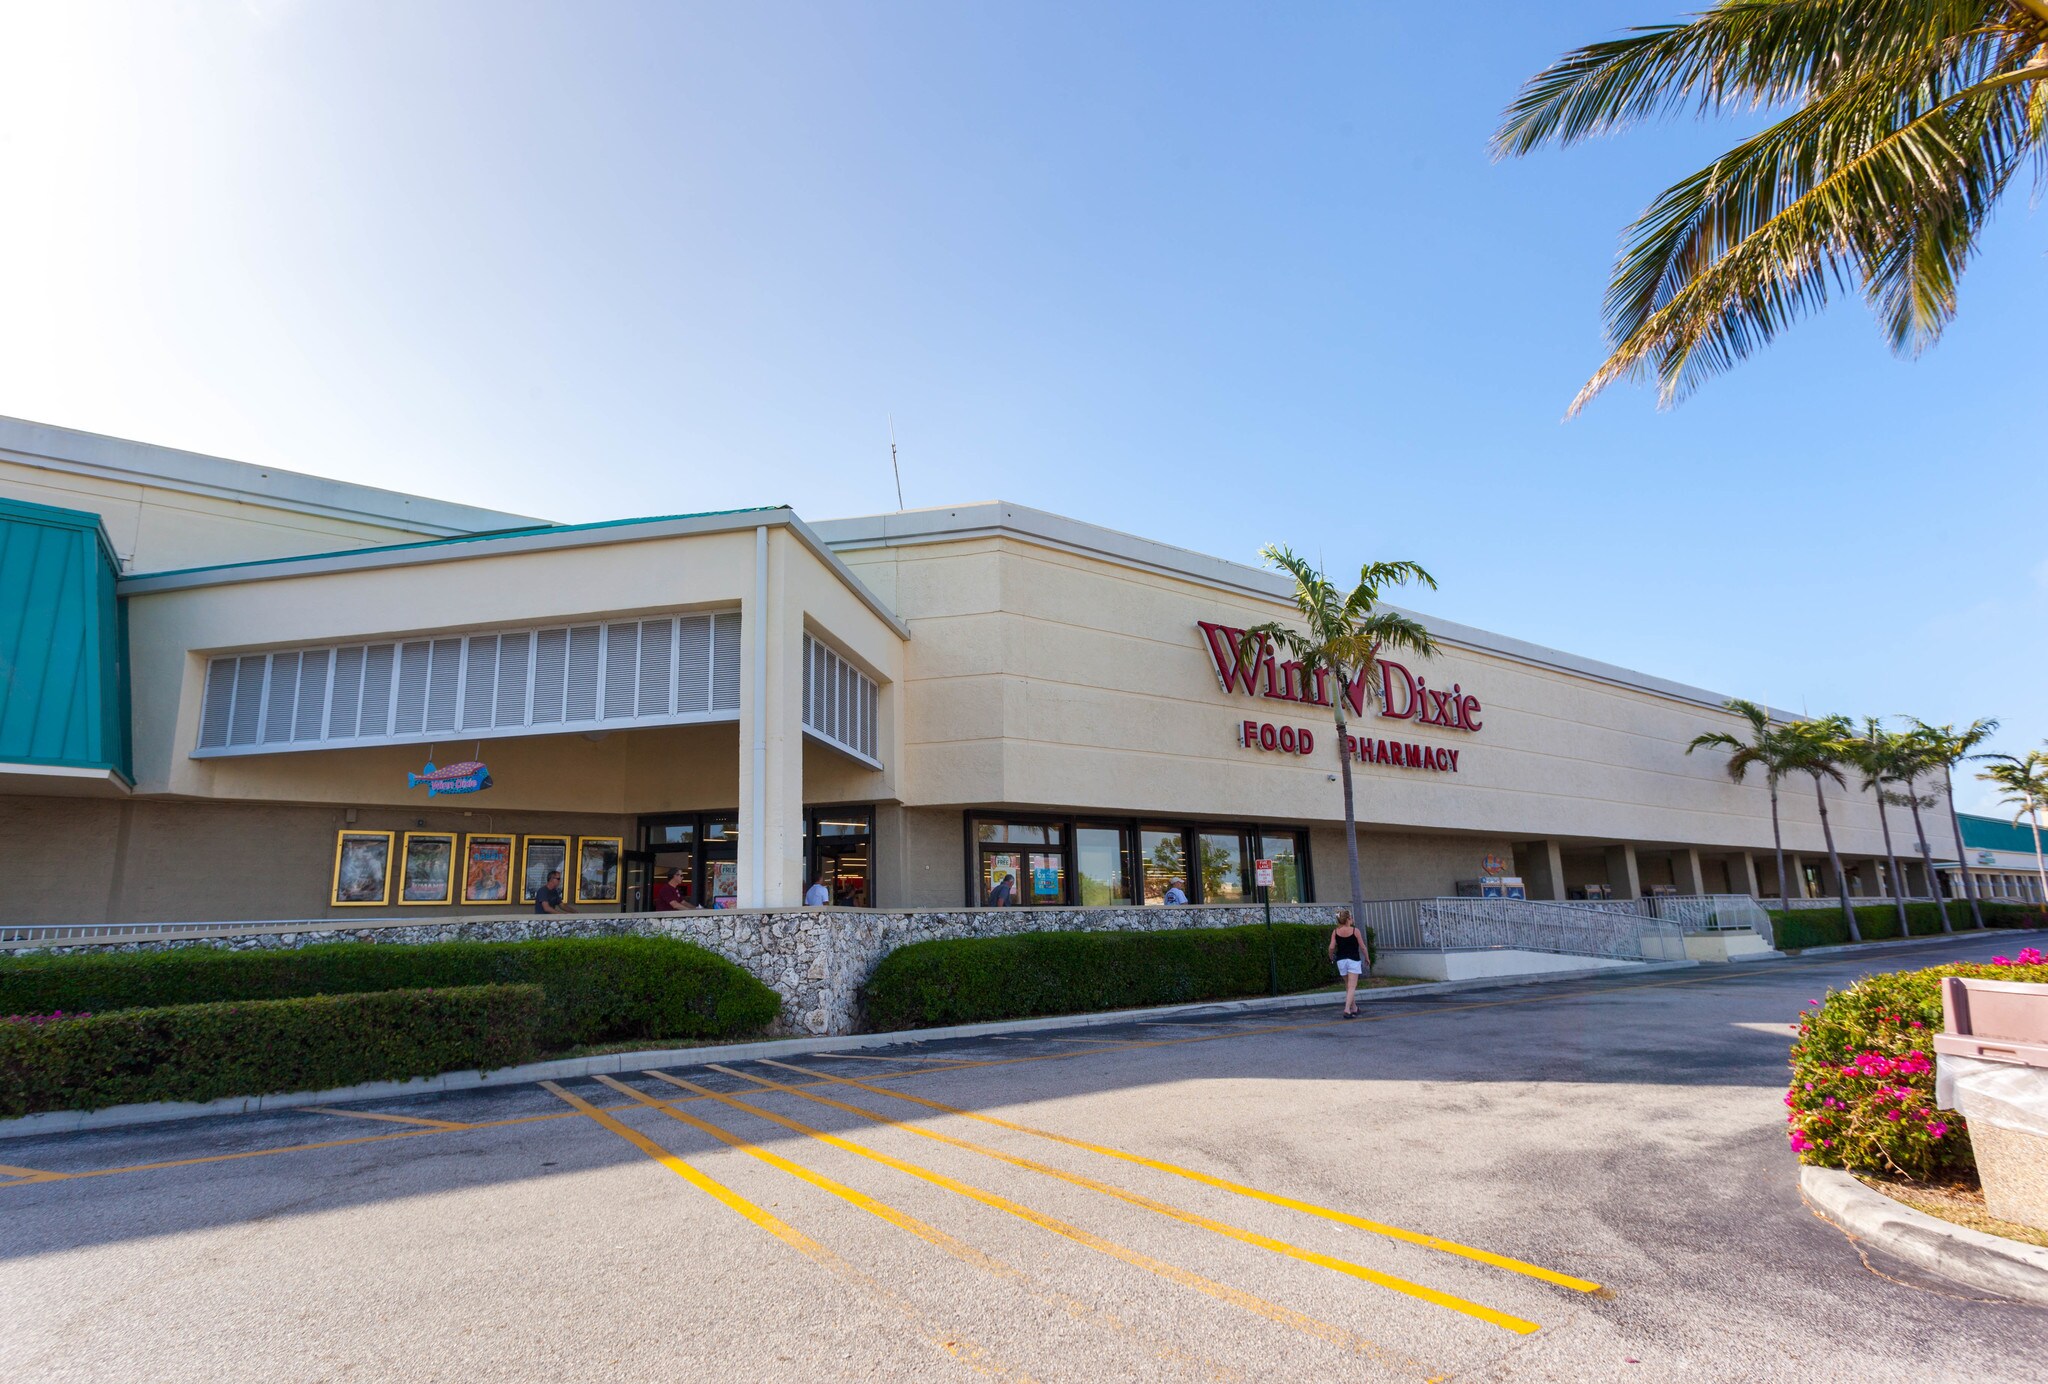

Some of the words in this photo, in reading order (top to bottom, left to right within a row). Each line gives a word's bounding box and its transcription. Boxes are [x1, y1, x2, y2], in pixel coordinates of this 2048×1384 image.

[1376, 658, 1483, 732] Dixie
[1240, 720, 1315, 755] FOOD
[1346, 734, 1460, 773] PHARMACY
